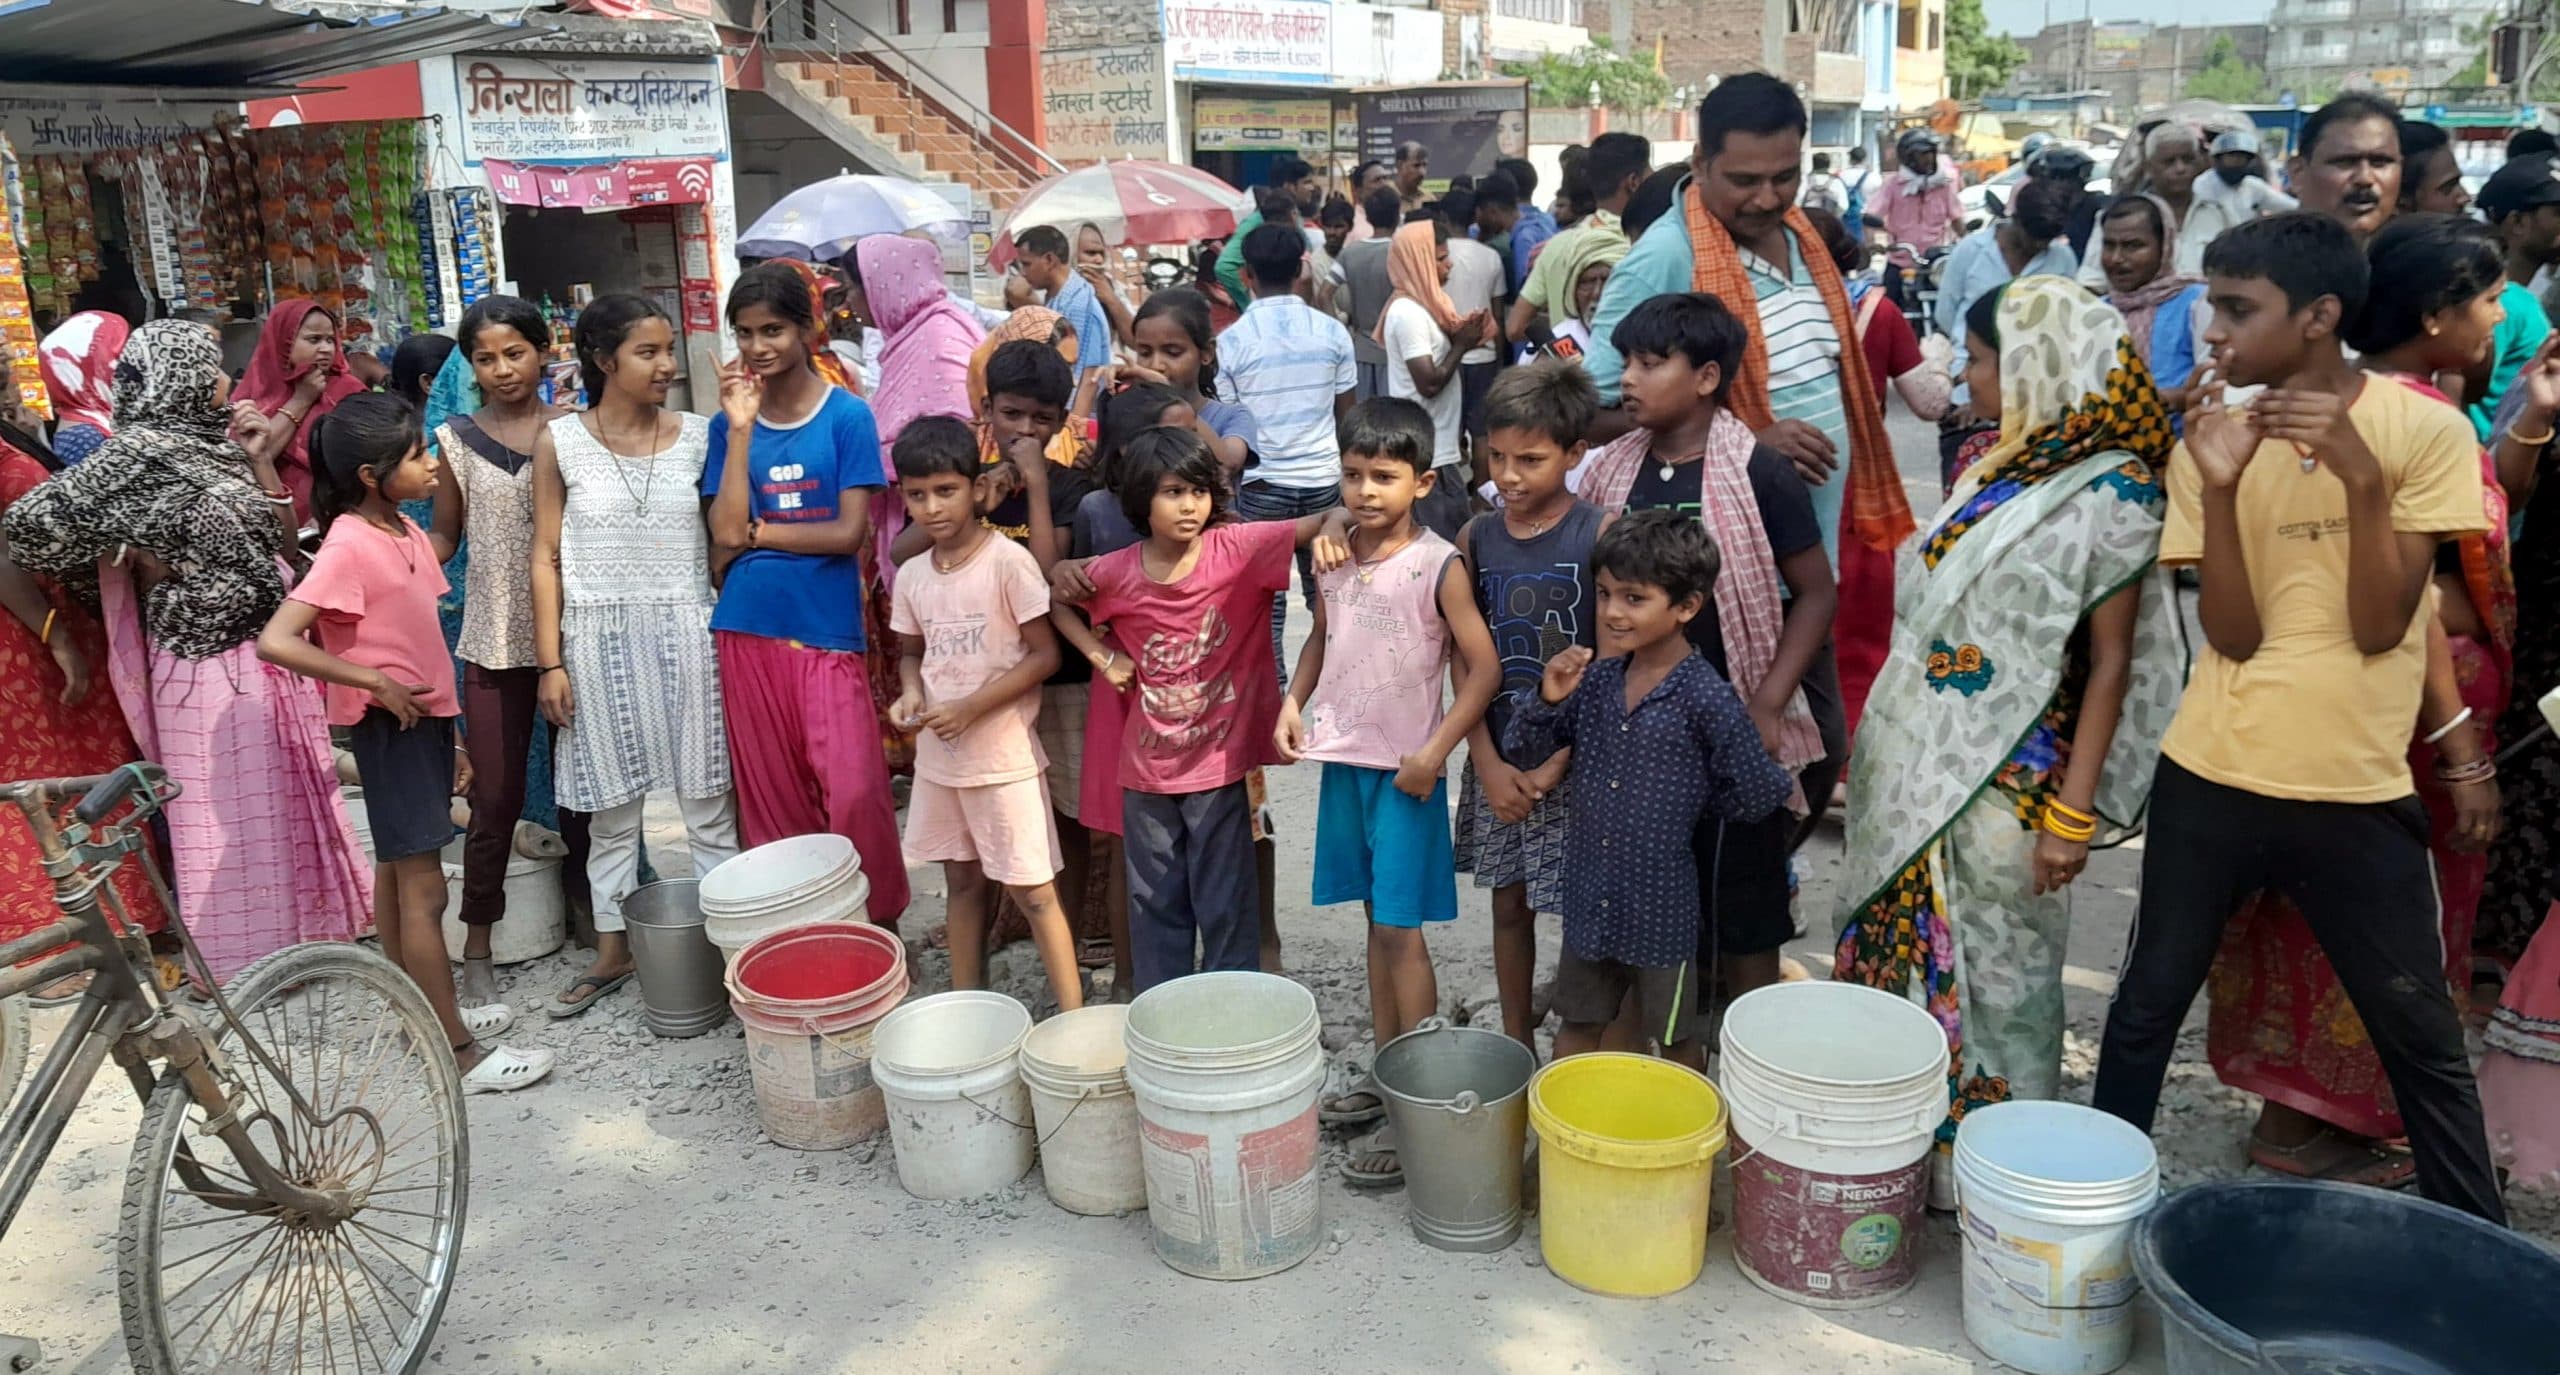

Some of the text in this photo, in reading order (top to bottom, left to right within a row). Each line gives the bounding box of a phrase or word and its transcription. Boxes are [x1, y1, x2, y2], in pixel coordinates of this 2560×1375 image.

[1096, 46, 1155, 78] स्टेशनरी
[1042, 80, 1153, 114] जेनरल स्टोर्स
[67, 124, 92, 148] पान
[769, 463, 804, 482] GOD
[779, 492, 803, 509] BE
[1323, 587, 1369, 609] BACK
[1352, 613, 1407, 634] FUTURE
[926, 624, 988, 656] YORK
[1842, 1178, 1907, 1201] NEROLAC
